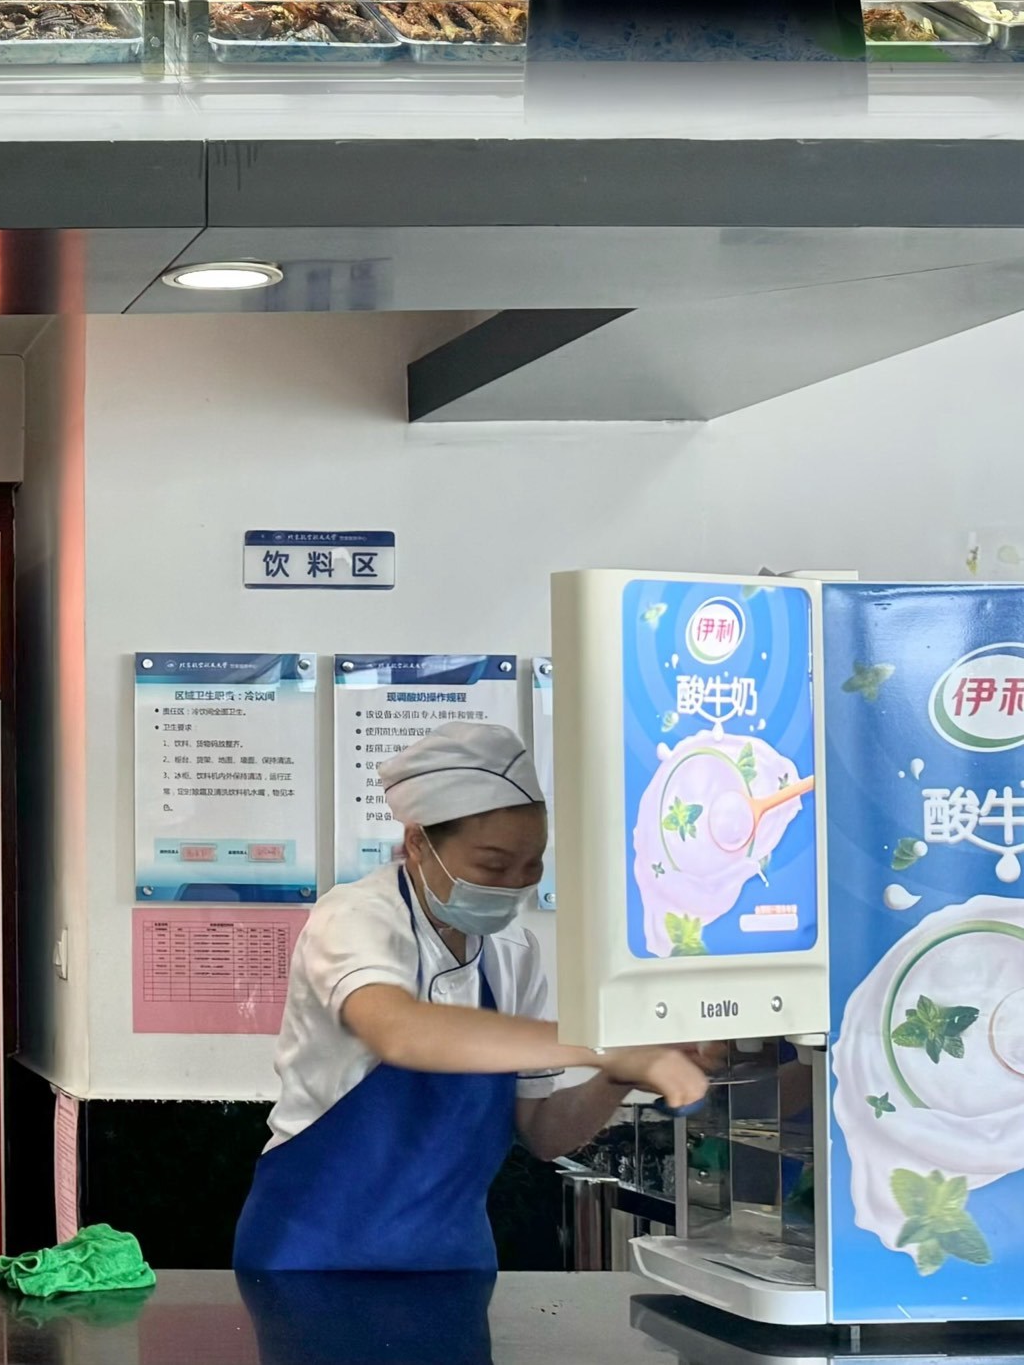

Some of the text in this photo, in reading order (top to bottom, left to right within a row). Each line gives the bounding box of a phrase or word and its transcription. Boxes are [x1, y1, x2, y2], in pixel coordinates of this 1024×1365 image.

[262, 549, 379, 579] 饮料区
[696, 617, 735, 644] 伊利
[676, 674, 759, 720] 酸牛奶
[700, 999, 739, 1019] LeaVo
